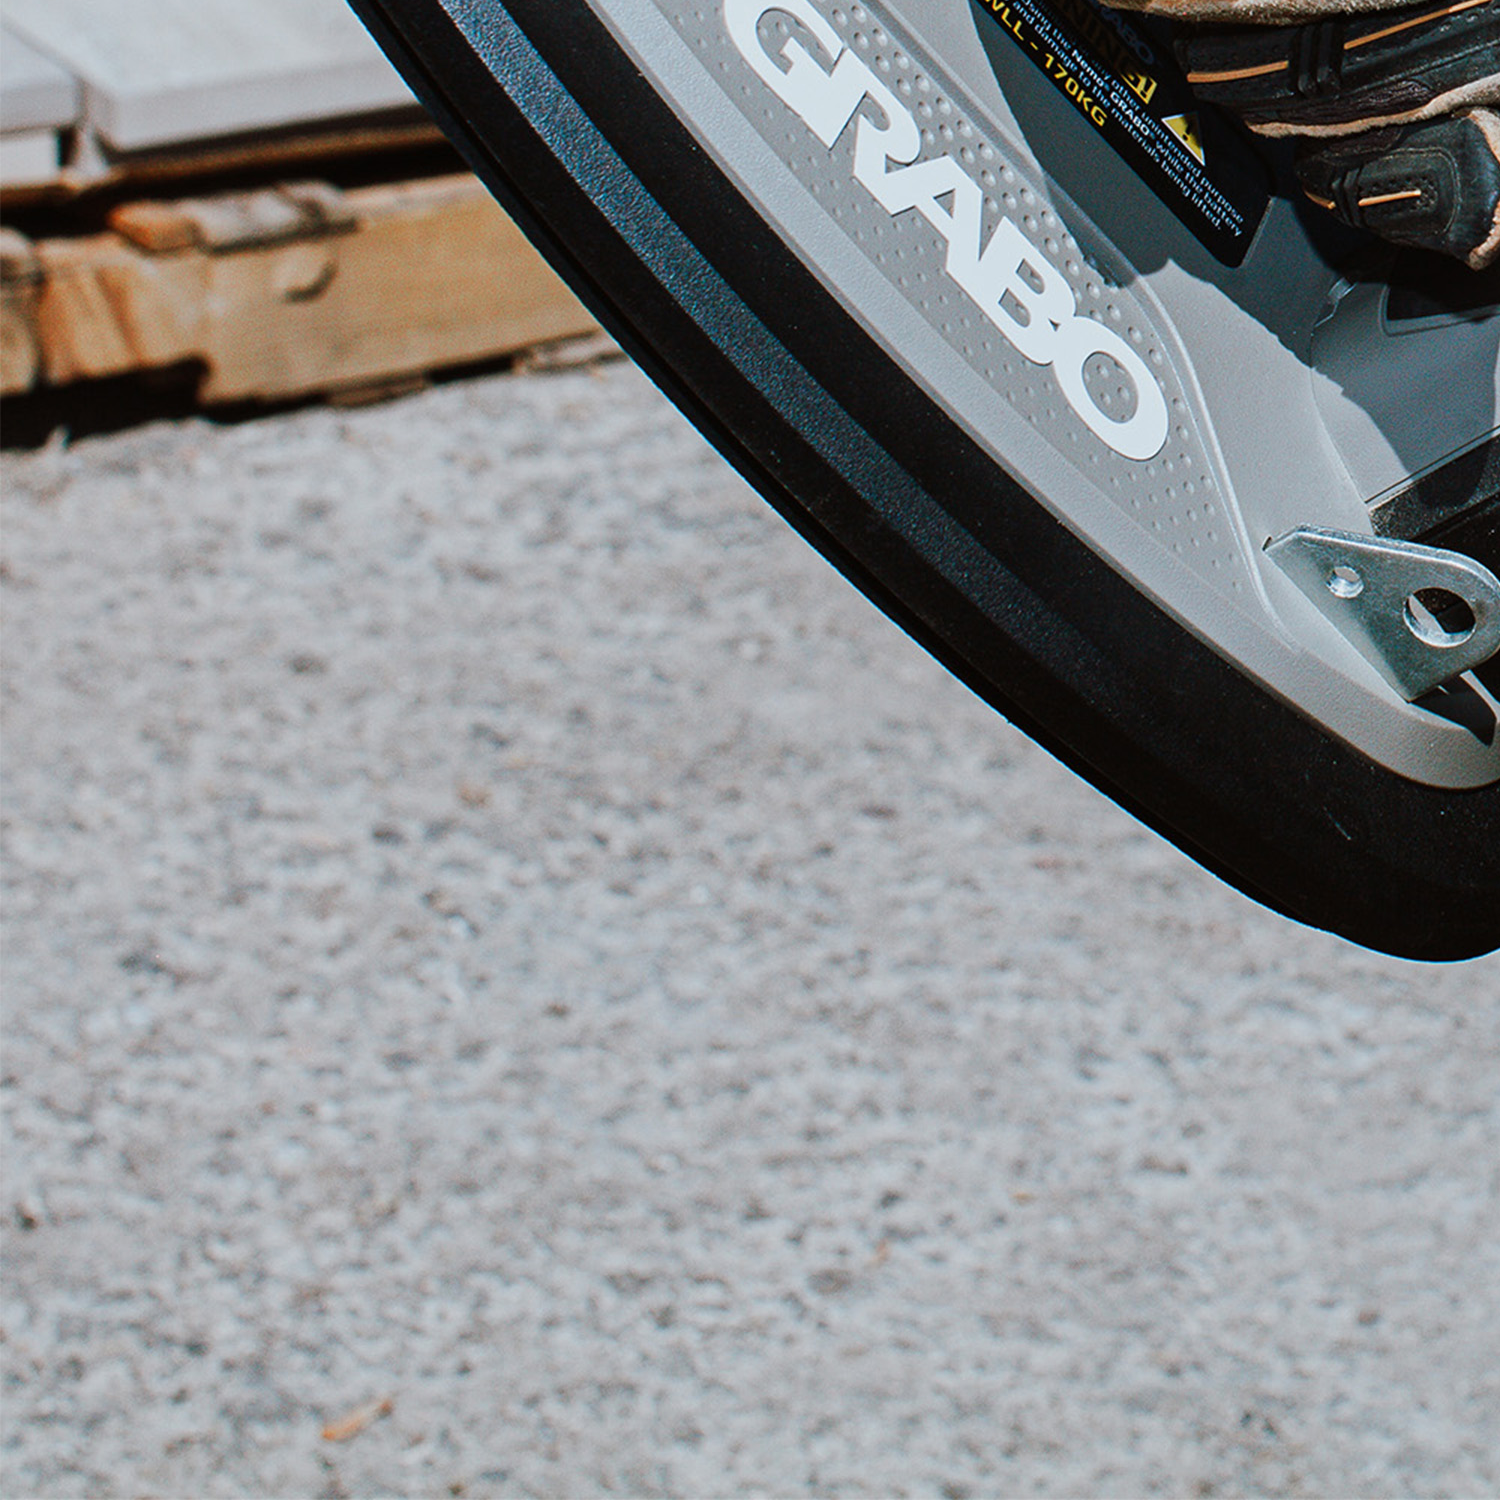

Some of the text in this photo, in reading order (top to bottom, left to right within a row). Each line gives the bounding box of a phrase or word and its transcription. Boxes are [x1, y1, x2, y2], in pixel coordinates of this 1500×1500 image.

[1012, 0, 1035, 25] and
[1033, 23, 1078, 72] damage
[1078, 70, 1091, 87] to
[1091, 84, 1111, 108] the
[1110, 107, 1160, 163] materials
[1160, 159, 1191, 197] being
[1044, 52, 1107, 127] 170KG
[1140, 111, 1202, 177] unintended
[1199, 176, 1244, 223] purpose
[1155, 139, 1184, 172] while
[1184, 171, 1203, 193] the
[1199, 191, 1242, 236] battery
